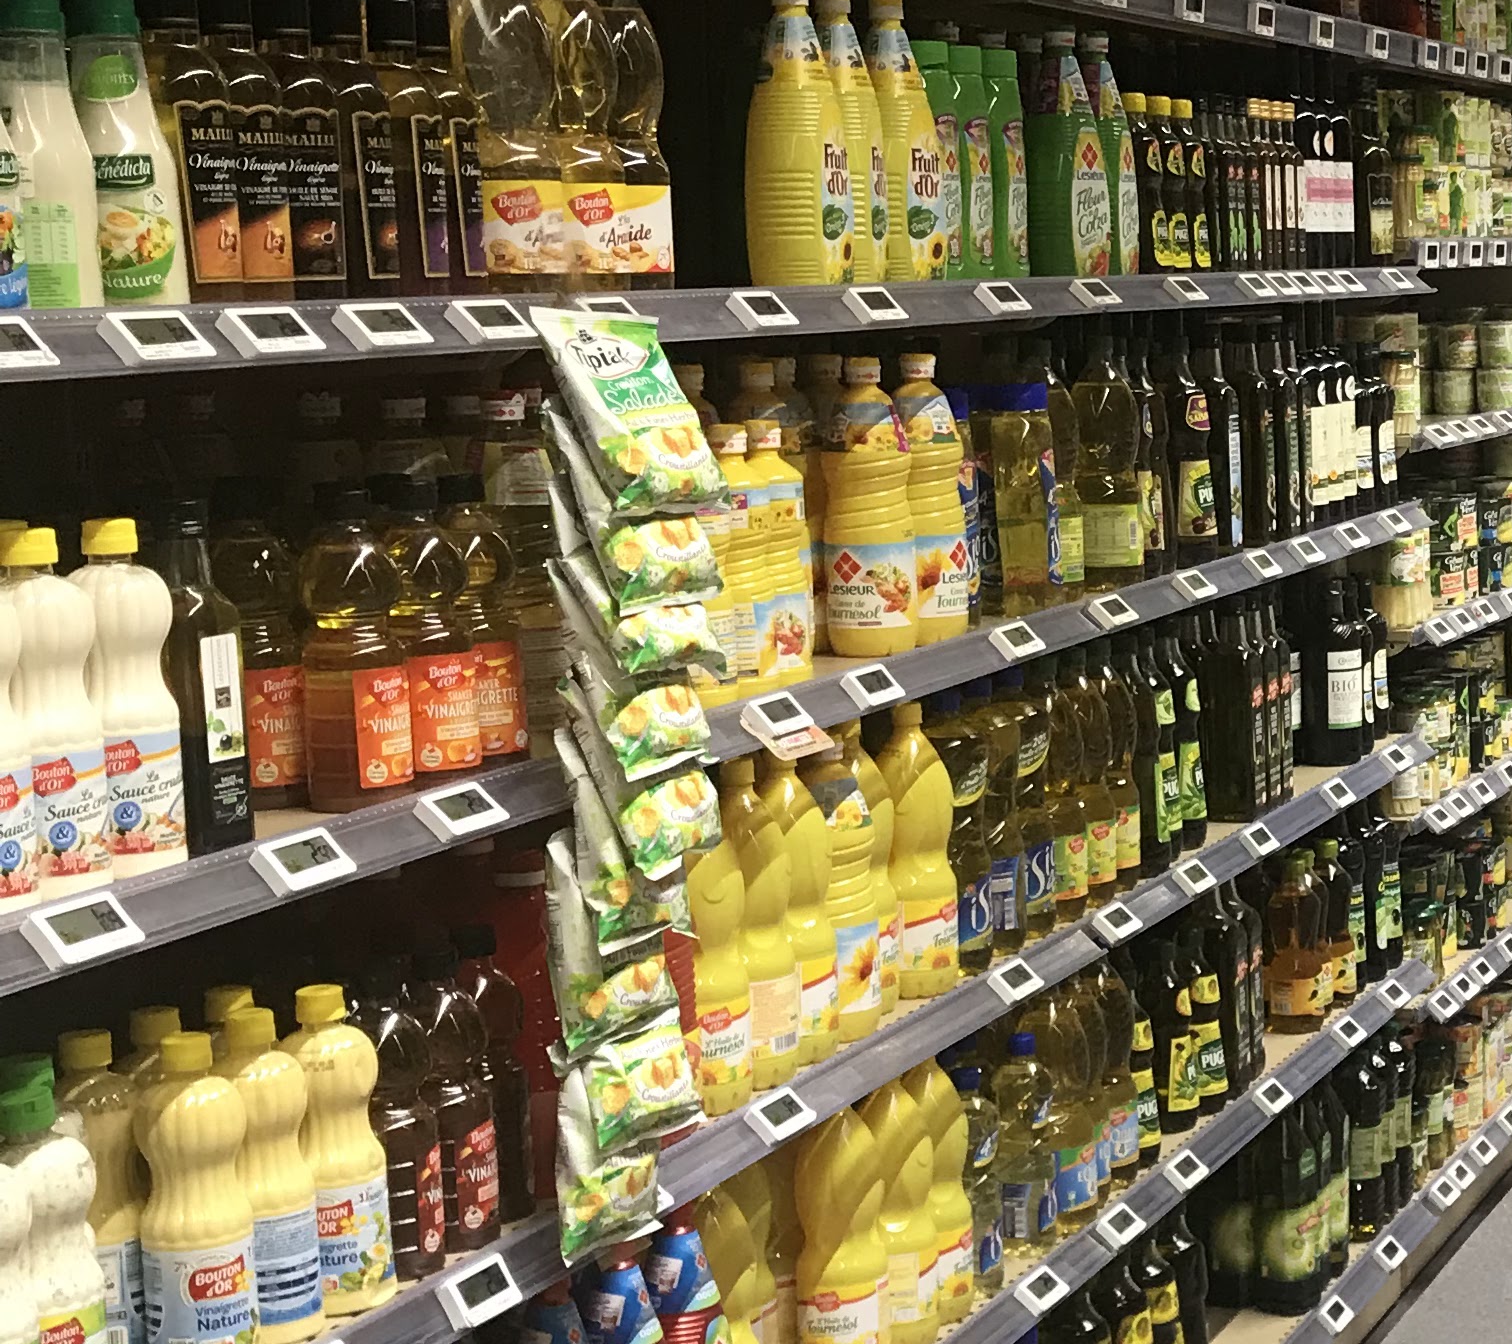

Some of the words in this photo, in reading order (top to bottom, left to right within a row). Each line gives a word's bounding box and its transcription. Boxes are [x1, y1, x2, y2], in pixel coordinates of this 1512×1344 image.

[911, 147, 941, 175] Fruit
[914, 173, 940, 199] d'Or
[570, 344, 635, 375] Tipiak
[428, 662, 462, 679] Bouton
[109, 784, 157, 803] Sauce
[44, 803, 90, 823] Sauce
[194, 1261, 242, 1288] BOUTON
[196, 1308, 251, 1332] Nature
